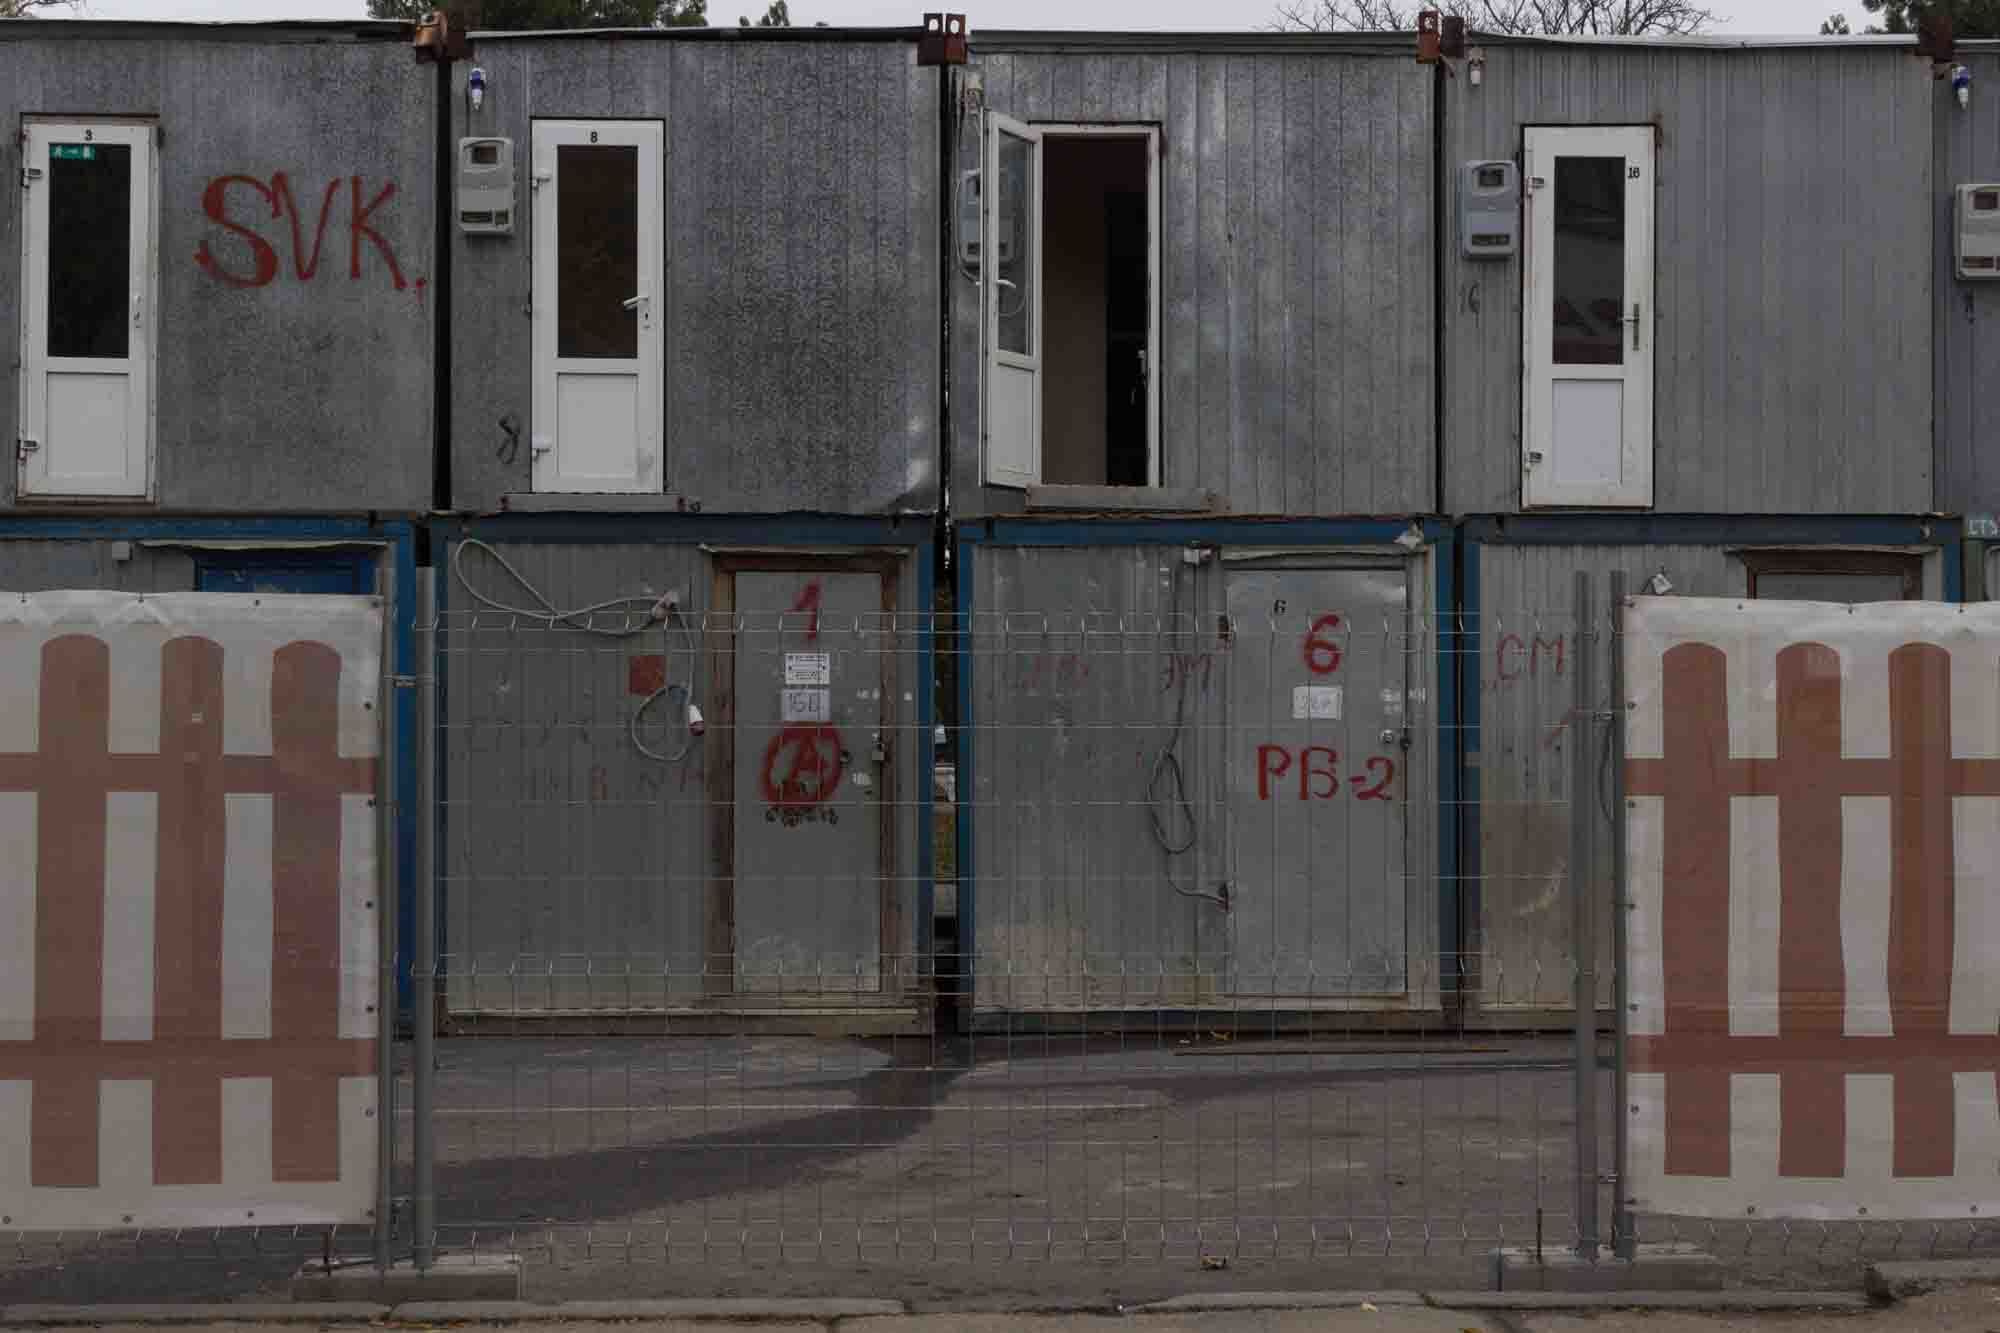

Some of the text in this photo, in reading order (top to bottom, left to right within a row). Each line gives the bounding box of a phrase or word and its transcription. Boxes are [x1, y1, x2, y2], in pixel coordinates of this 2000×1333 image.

[84, 128, 93, 141] 3
[590, 131, 598, 143] 8
[784, 576, 823, 641] 1
[1303, 613, 1344, 676] 6
